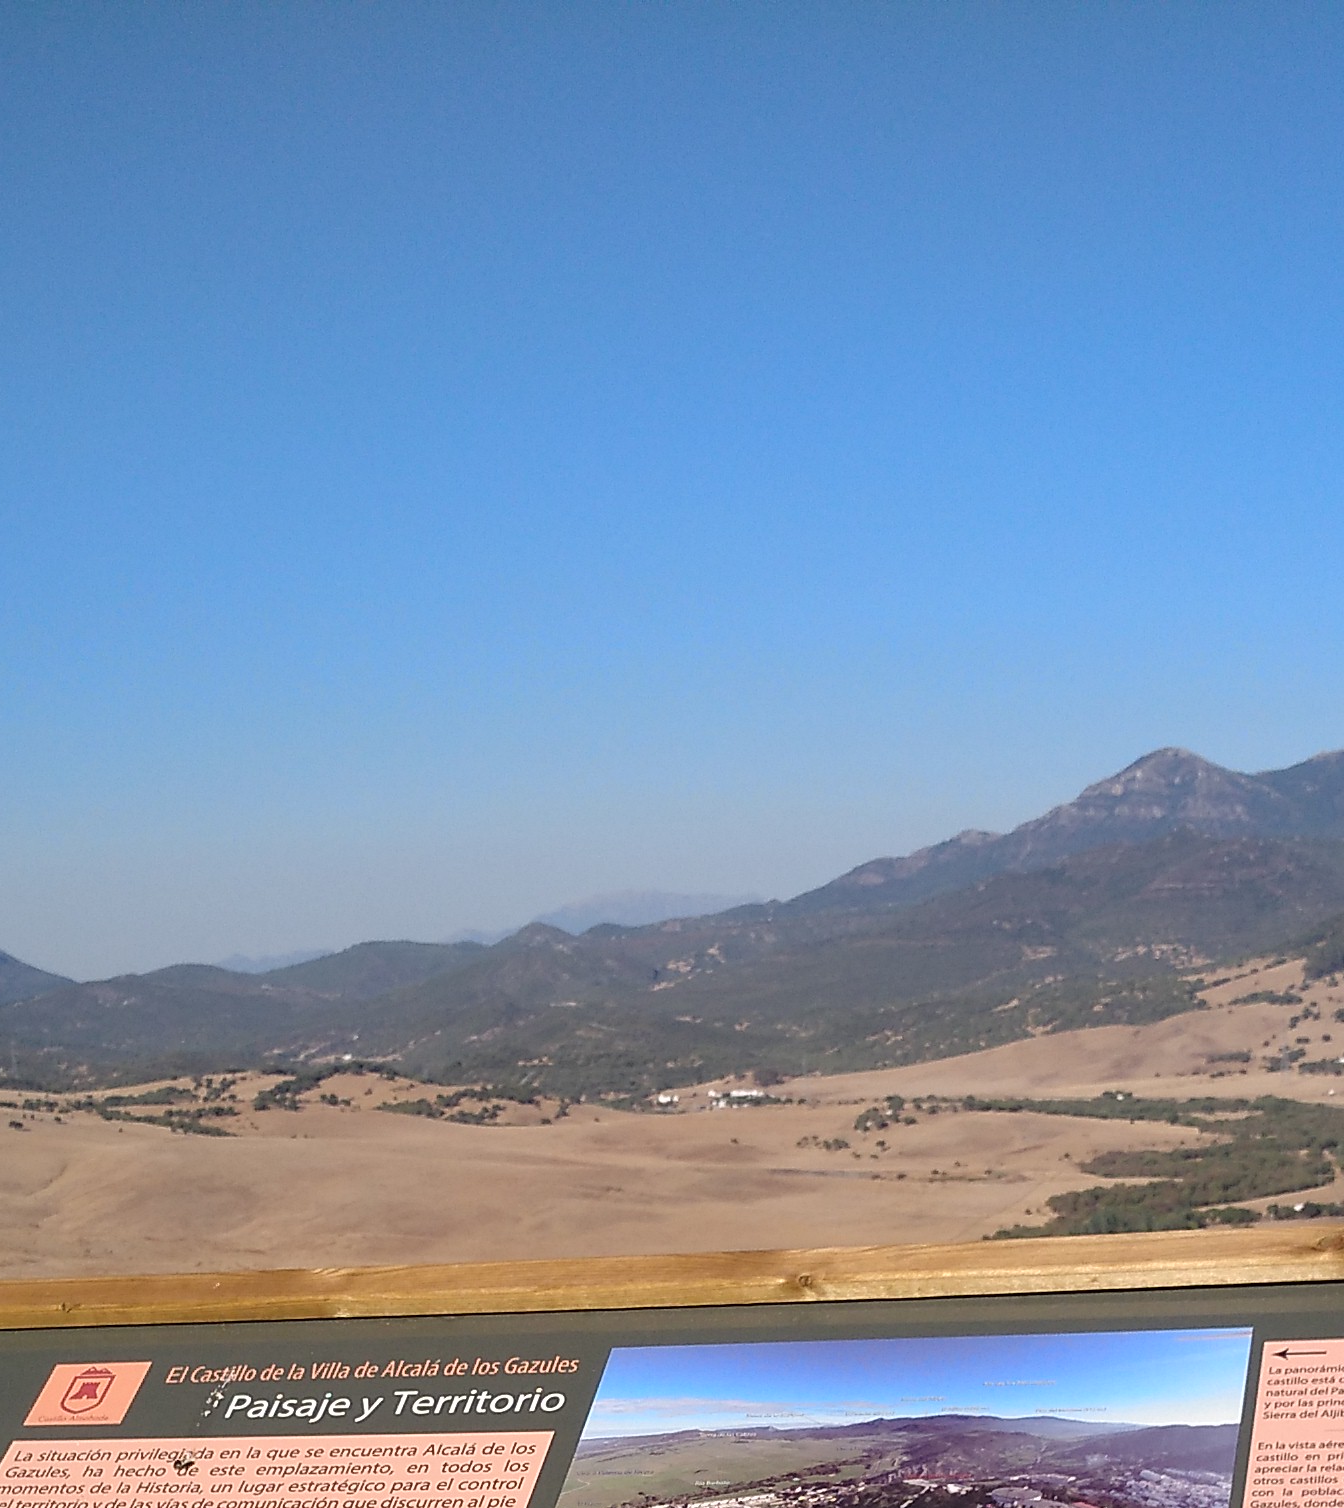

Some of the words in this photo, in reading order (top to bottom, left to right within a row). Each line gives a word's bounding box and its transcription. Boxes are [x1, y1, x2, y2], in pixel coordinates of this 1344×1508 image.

[165, 1366, 189, 1383] El
[190, 1364, 257, 1383] Castillo
[260, 1364, 284, 1381] de
[286, 1363, 305, 1380] la
[311, 1362, 351, 1379] Villa
[354, 1361, 379, 1378] de
[380, 1359, 441, 1377] Alcalá
[443, 1358, 468, 1376] de
[471, 1357, 501, 1375] los
[504, 1355, 579, 1374] Gazules
[1266, 1387, 1308, 1397] natural
[1309, 1386, 1329, 1395] del
[224, 1392, 351, 1423] Paisaje
[354, 1397, 384, 1423] y
[394, 1387, 565, 1415] Territorio
[1263, 1411, 1296, 1420] Sierra
[1299, 1410, 1319, 1419] del
[14, 1450, 33, 1462] La
[37, 1449, 112, 1462] situación
[219, 1450, 241, 1459] en
[246, 1446, 261, 1459] la
[266, 1449, 300, 1461] que
[304, 1448, 325, 1458] se
[329, 1445, 418, 1458] encuentra
[422, 1442, 477, 1456] Alcalá
[482, 1442, 505, 1455] de
[510, 1442, 536, 1455] los
[1258, 1442, 1273, 1451] En
[1275, 1441, 1286, 1450] la
[1288, 1441, 1316, 1449] vista
[89, 1482, 112, 1494] de
[116, 1481, 131, 1494] la
[135, 1481, 203, 1495] Historia,
[210, 1484, 233, 1493] un
[238, 1480, 285, 1496] lugar
[288, 1479, 386, 1495] estratégico
[389, 1481, 431, 1494] para
[436, 1478, 454, 1491] el
[458, 1476, 525, 1491] control
